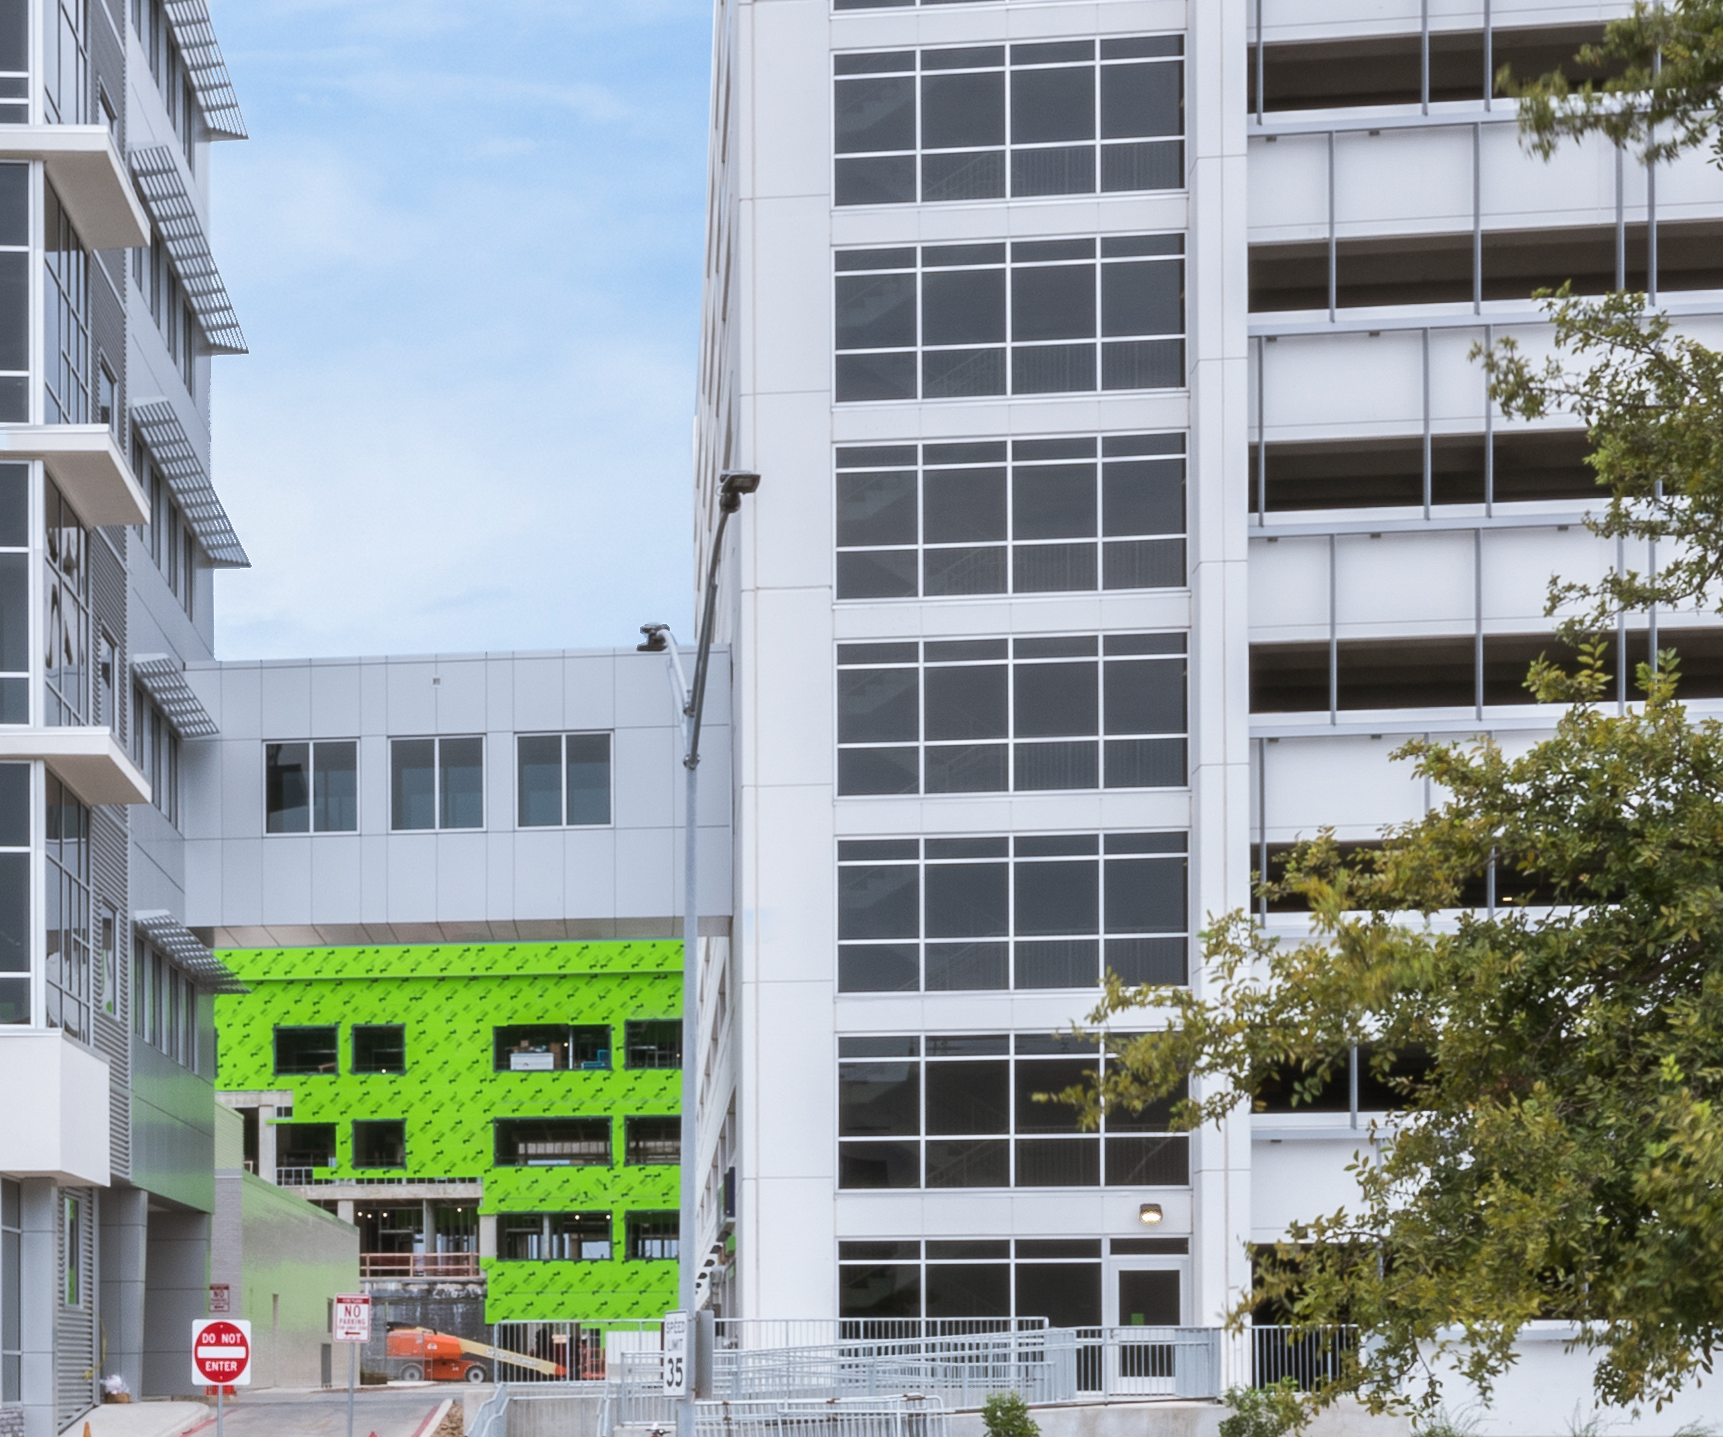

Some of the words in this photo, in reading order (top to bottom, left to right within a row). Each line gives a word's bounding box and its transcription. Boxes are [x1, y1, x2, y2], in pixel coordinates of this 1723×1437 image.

[344, 1305, 362, 1318] NO
[202, 1332, 216, 1344] DO
[221, 1332, 242, 1344] NOT
[667, 1338, 684, 1352] LIMIT
[205, 1360, 238, 1372] ENTER
[666, 1357, 684, 1388] 35
